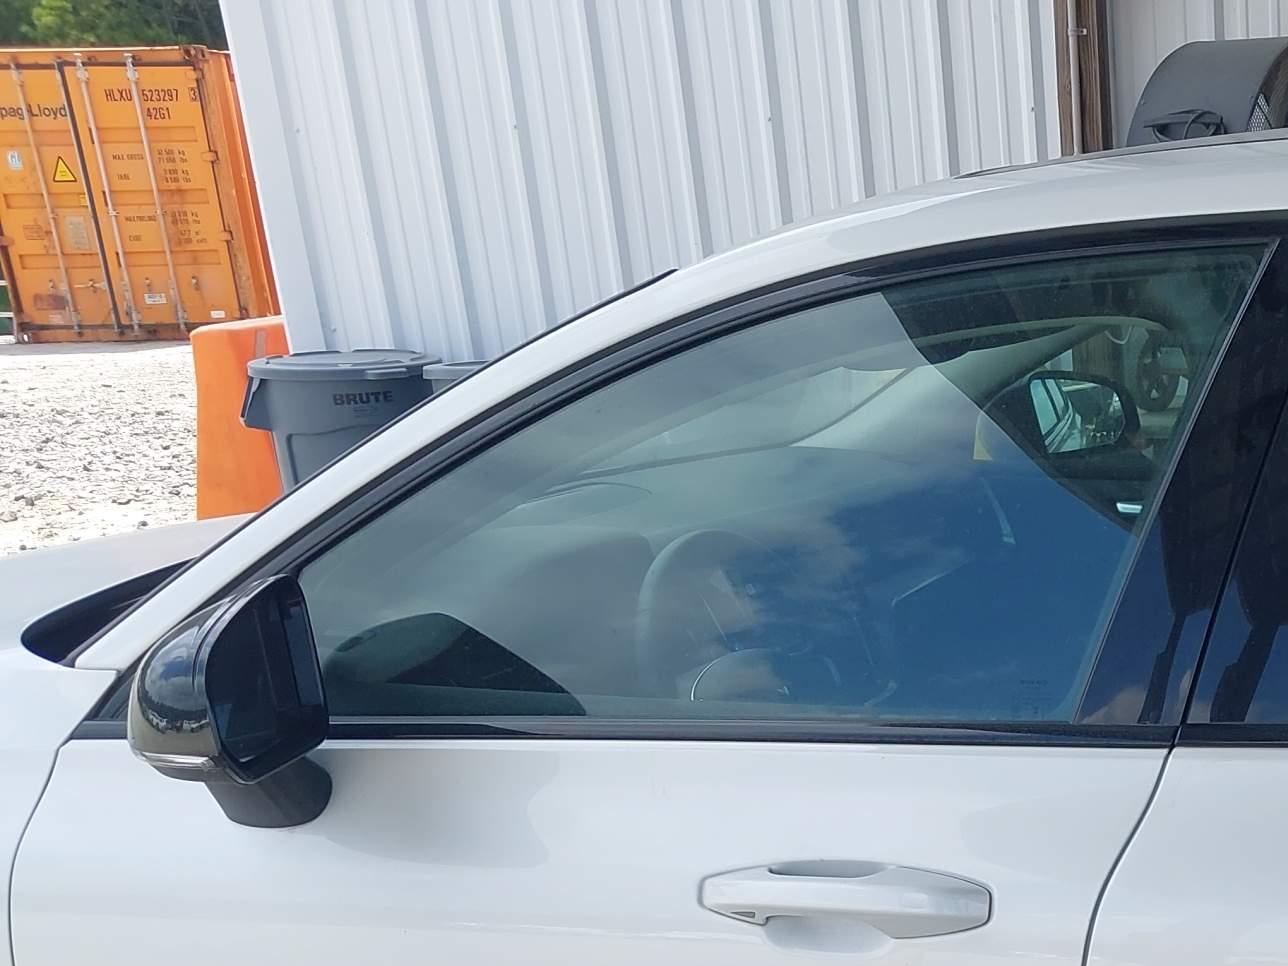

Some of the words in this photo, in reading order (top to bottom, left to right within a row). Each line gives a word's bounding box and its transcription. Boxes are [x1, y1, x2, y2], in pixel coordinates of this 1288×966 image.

[104, 88, 132, 102] HLXU
[141, 88, 179, 102] 523297
[190, 88, 198, 102] 3
[146, 107, 171, 120] 42G1
[332, 391, 393, 406] BRUTE
